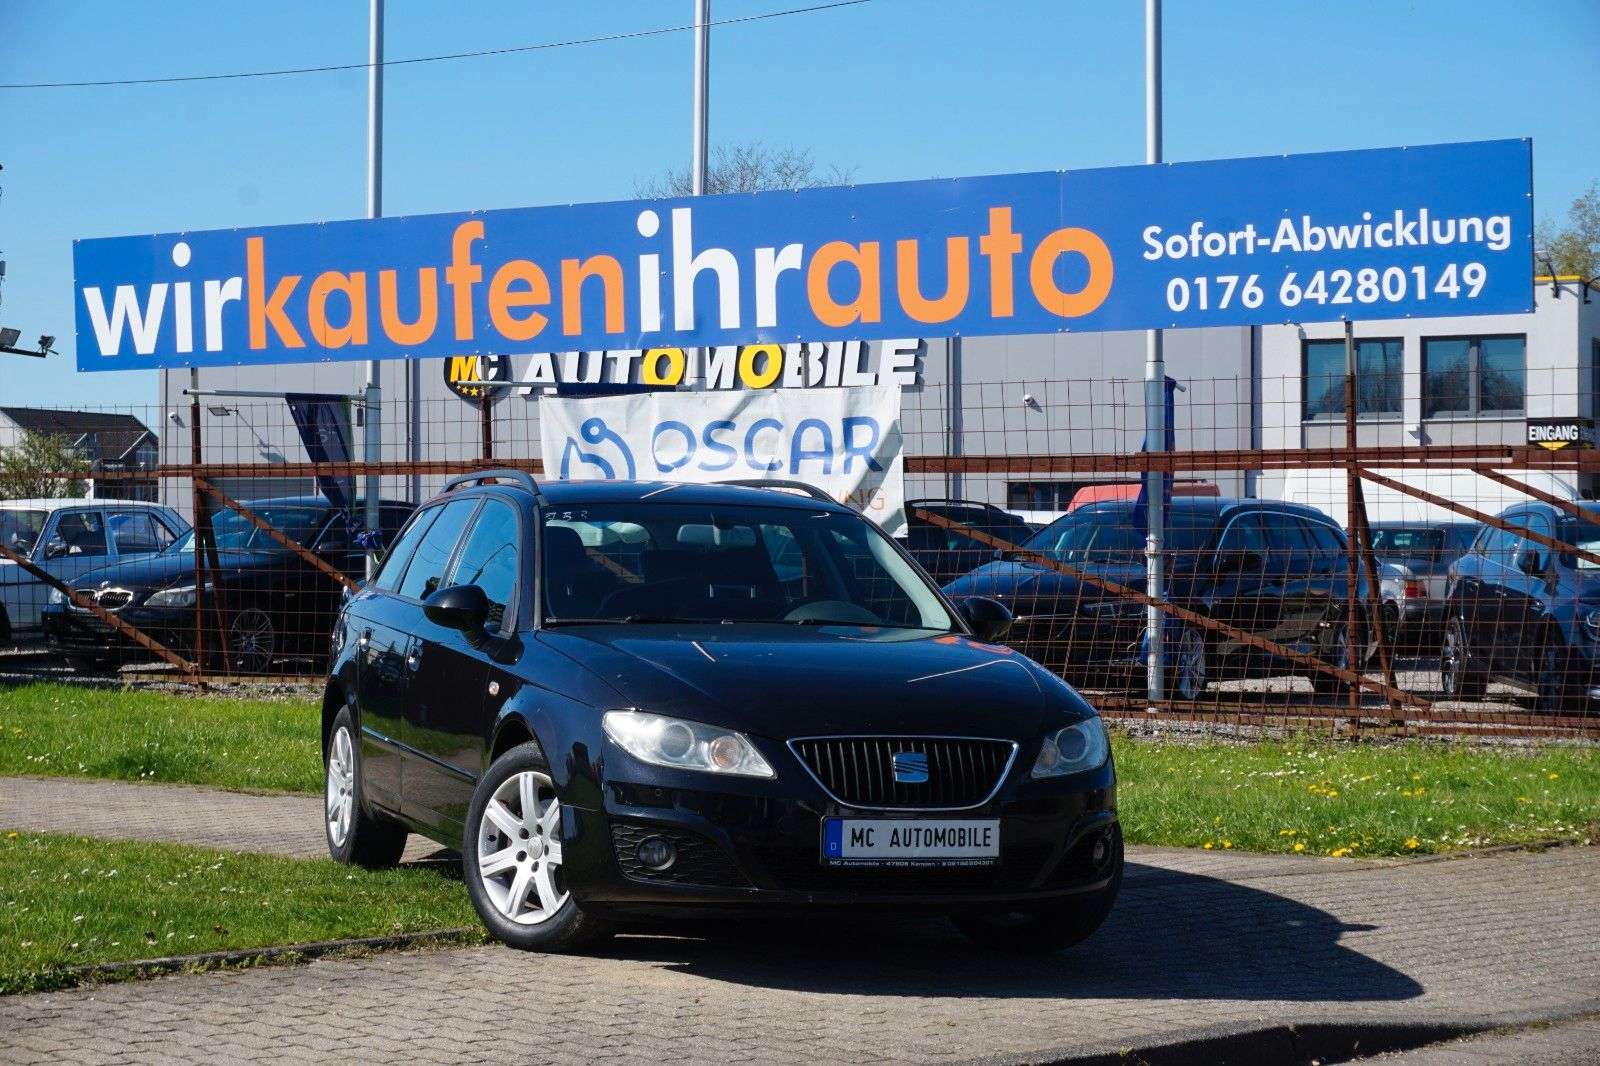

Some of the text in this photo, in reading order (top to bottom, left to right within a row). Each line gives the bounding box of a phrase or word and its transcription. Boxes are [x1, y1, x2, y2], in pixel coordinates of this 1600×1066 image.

[1143, 208, 1511, 260] Sofort-Abwicklung
[83, 206, 1114, 356] wirkaufenihrauto
[1167, 262, 1487, 312] 0176 64280149
[450, 339, 919, 395] MC AUTOMOBILE
[651, 416, 883, 475] OSCAR
[1528, 425, 1579, 441] EINGANG
[851, 827, 991, 847] MC AUTOMOBILE
